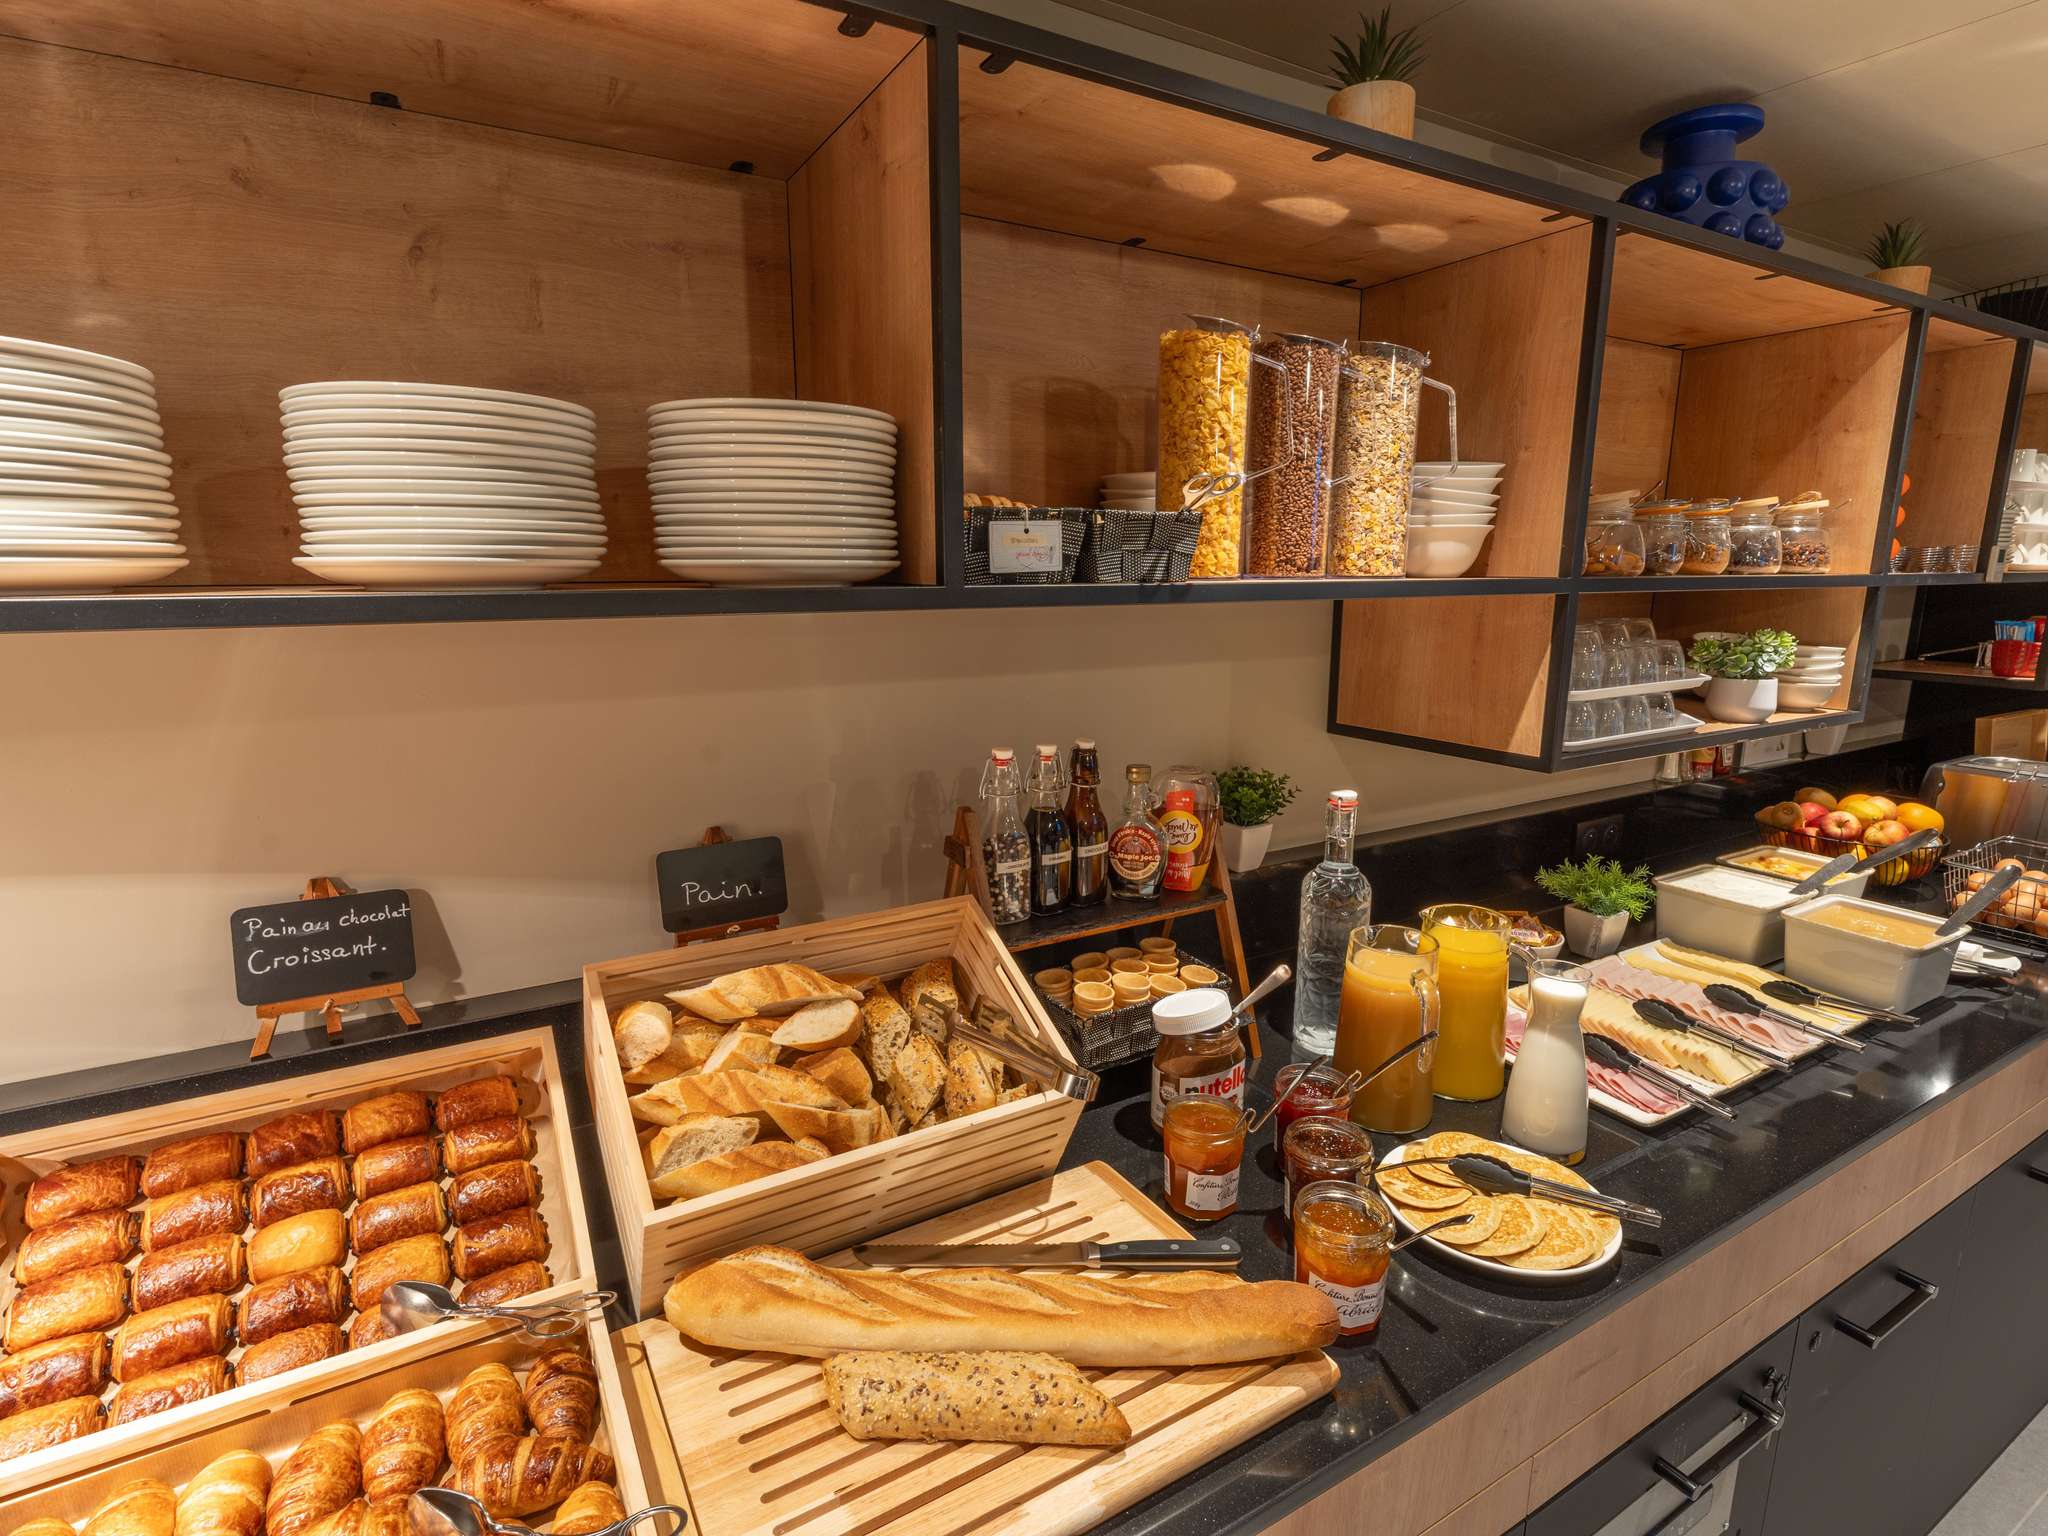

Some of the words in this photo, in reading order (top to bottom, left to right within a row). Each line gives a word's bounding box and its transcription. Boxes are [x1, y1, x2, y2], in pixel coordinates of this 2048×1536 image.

[1117, 853, 1140, 861] Maple
[243, 917, 296, 942] Pain
[302, 920, 330, 932] au
[339, 903, 412, 927] chocolat
